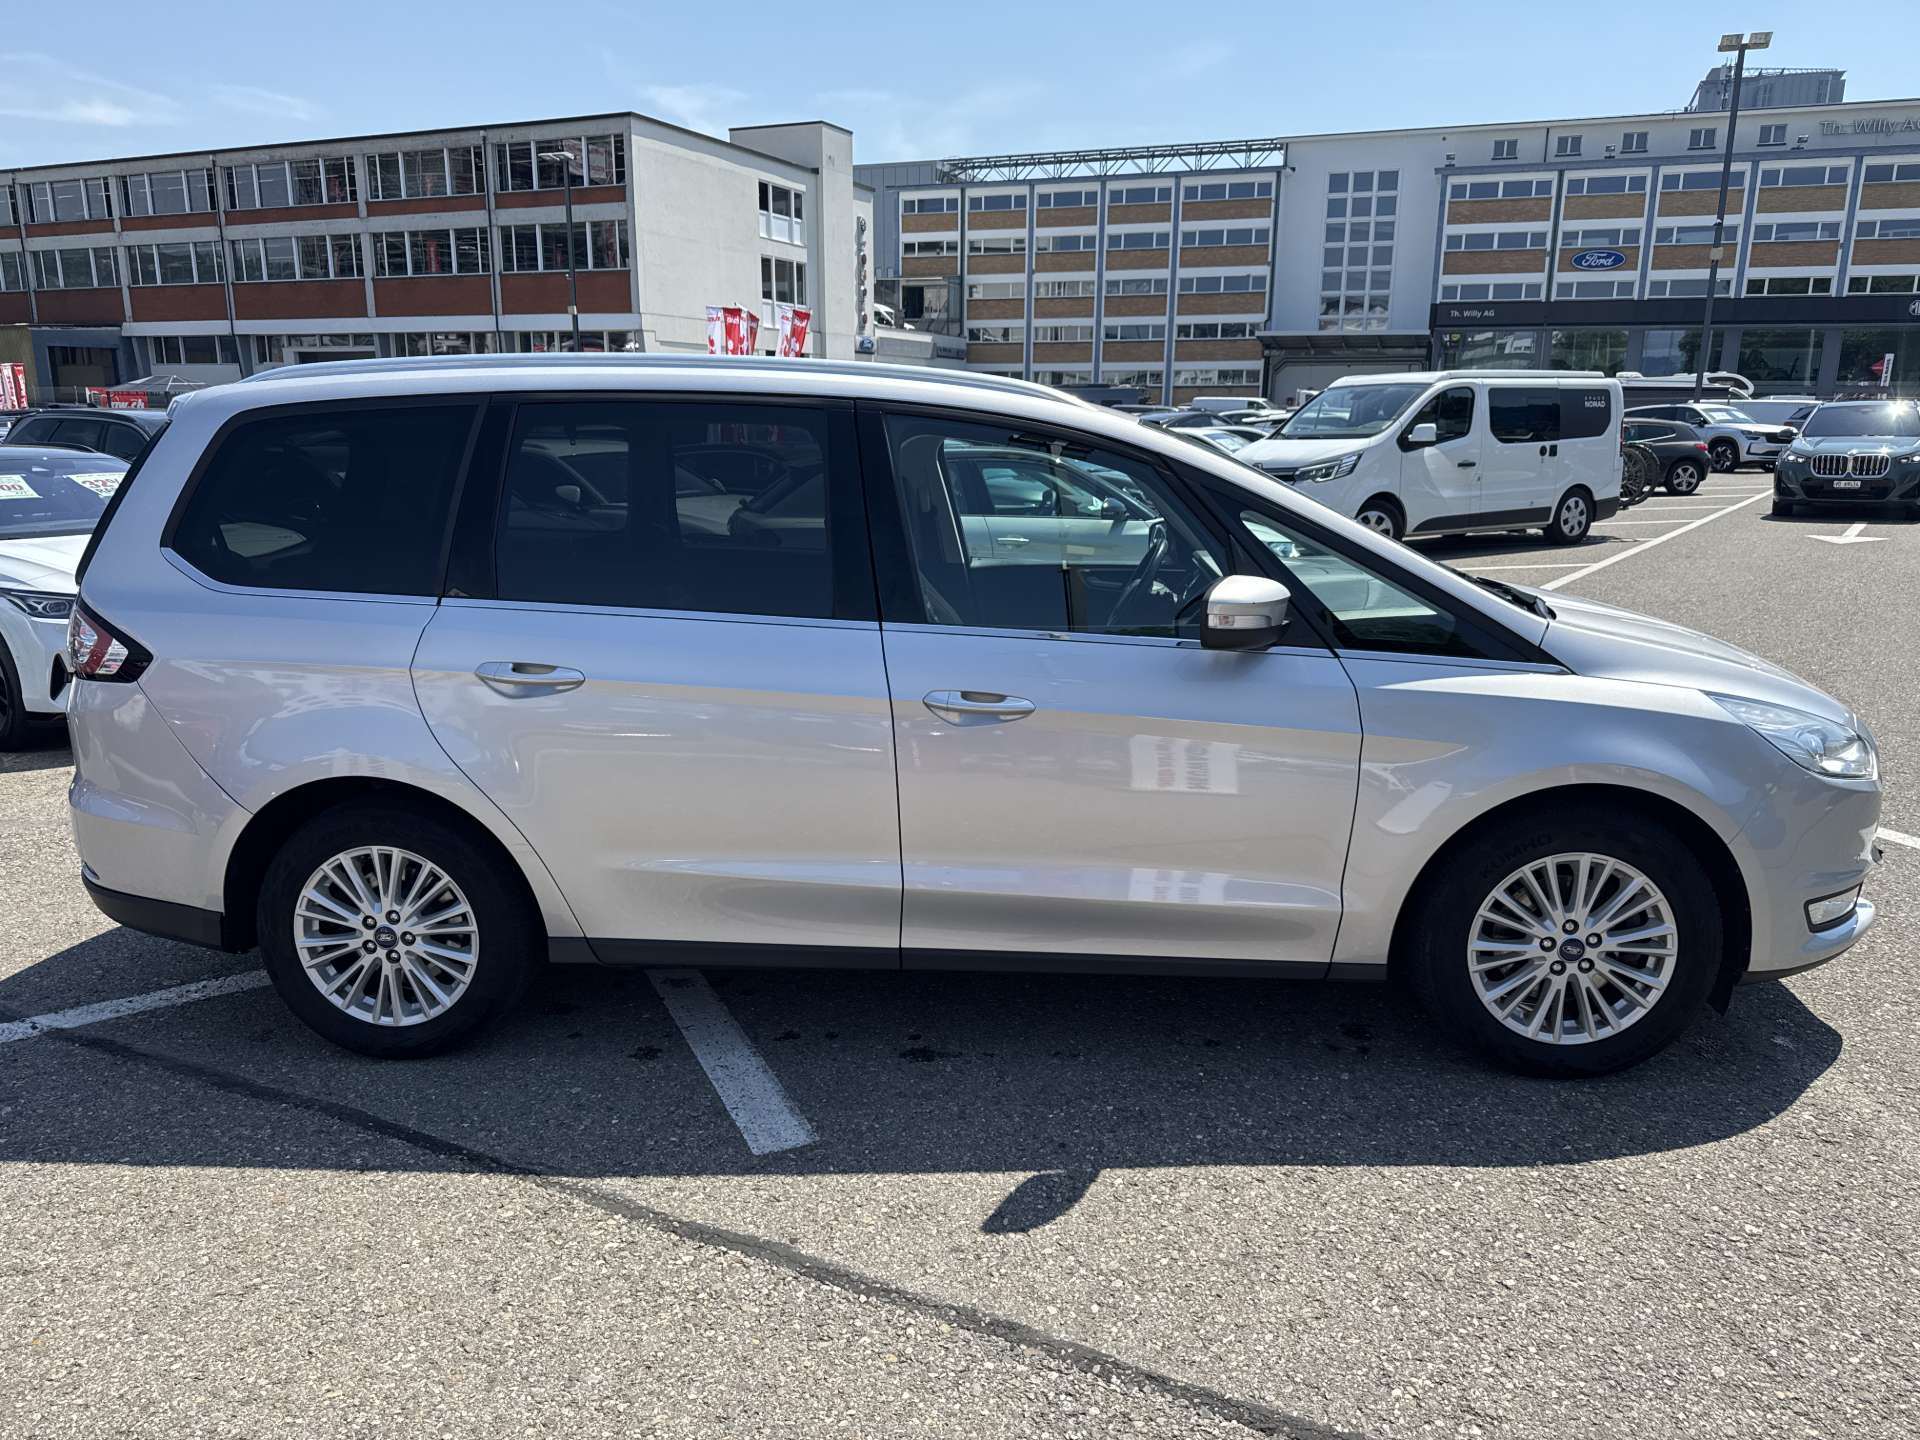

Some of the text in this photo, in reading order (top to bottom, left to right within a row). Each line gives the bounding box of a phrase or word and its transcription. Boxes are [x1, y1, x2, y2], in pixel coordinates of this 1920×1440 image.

[1854, 119, 1896, 136] Willy
[1902, 118, 1920, 132] A
[1463, 309, 1482, 319] Willy
[1483, 309, 1495, 317] AG
